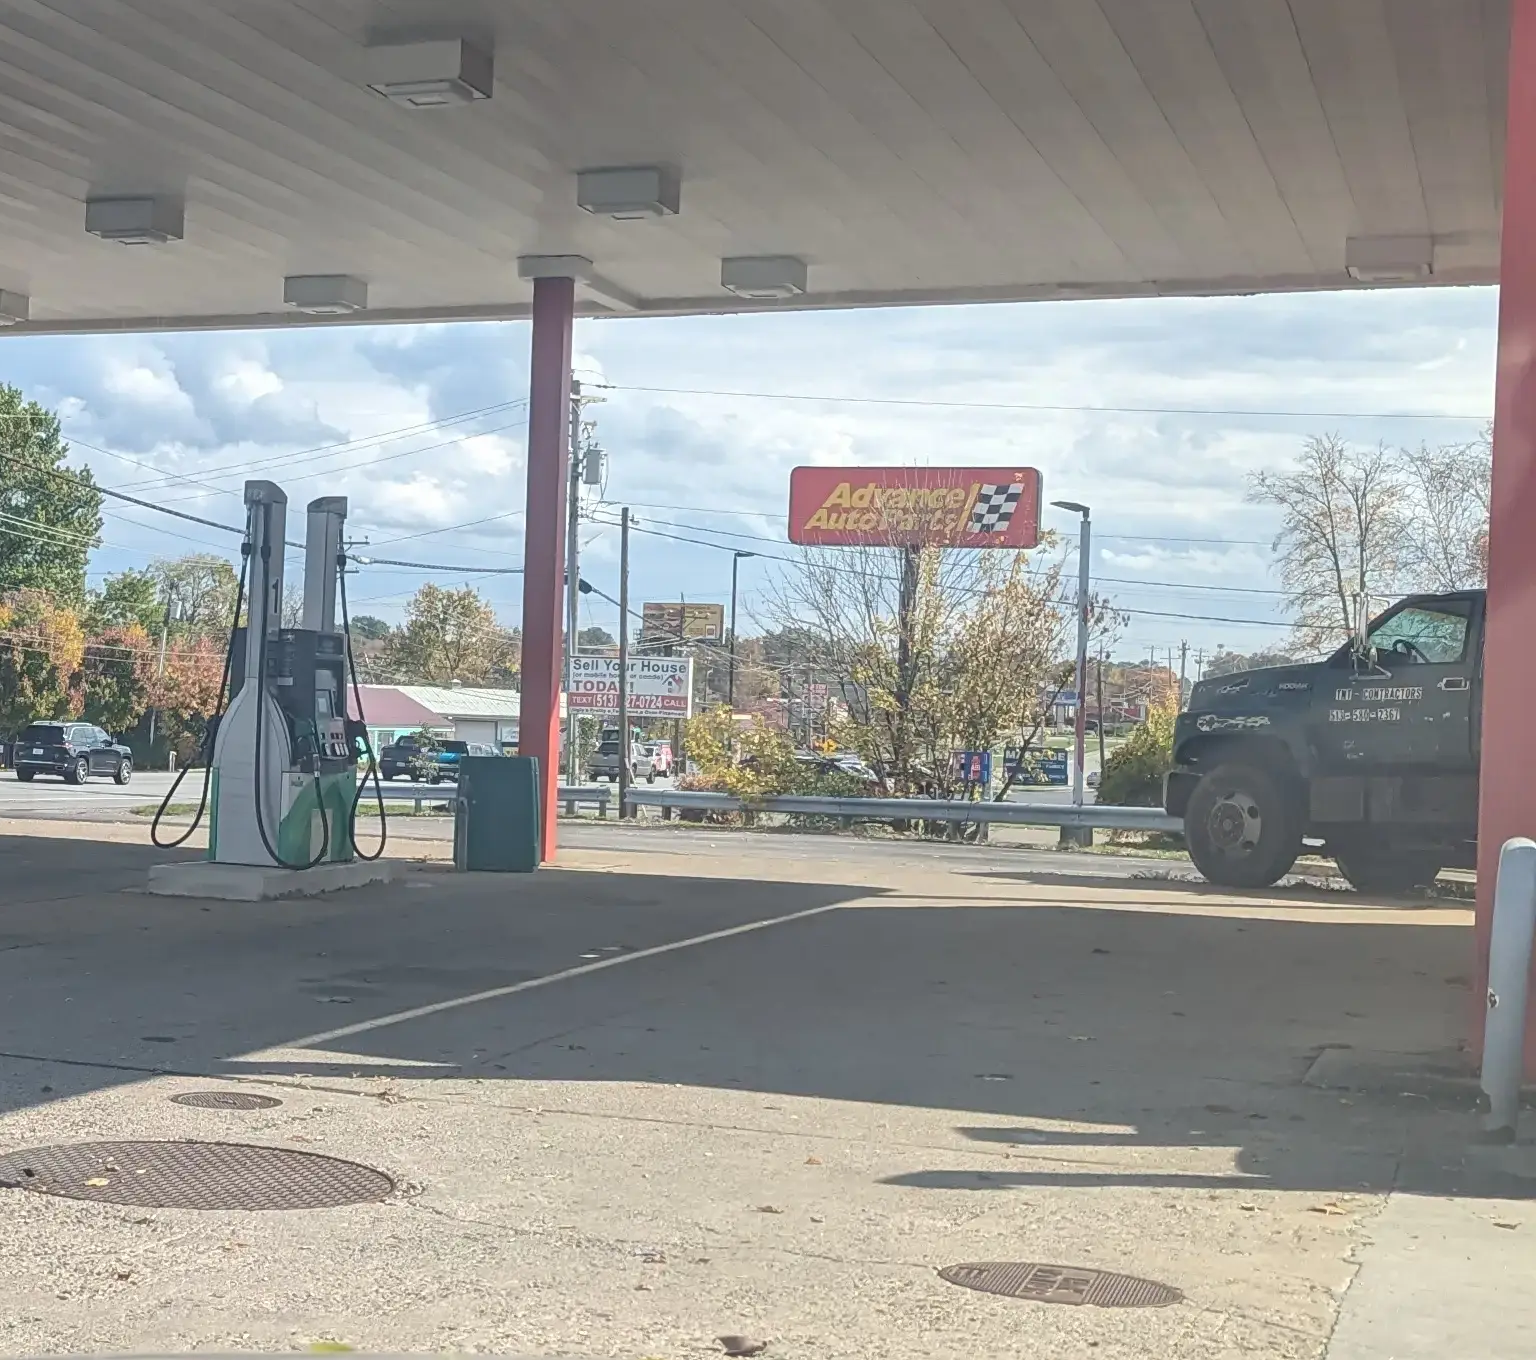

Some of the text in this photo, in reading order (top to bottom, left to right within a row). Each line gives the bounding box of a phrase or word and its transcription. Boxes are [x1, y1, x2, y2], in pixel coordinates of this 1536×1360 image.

[822, 482, 966, 509] Advance
[804, 508, 958, 533] Auto Parts
[272, 578, 279, 613] 1
[573, 658, 687, 674] Sell Yor House
[572, 680, 634, 693] TODA!
[1362, 686, 1423, 701] CONTRACTORS
[572, 694, 686, 709] TEXT (513) 27-0724 CALL
